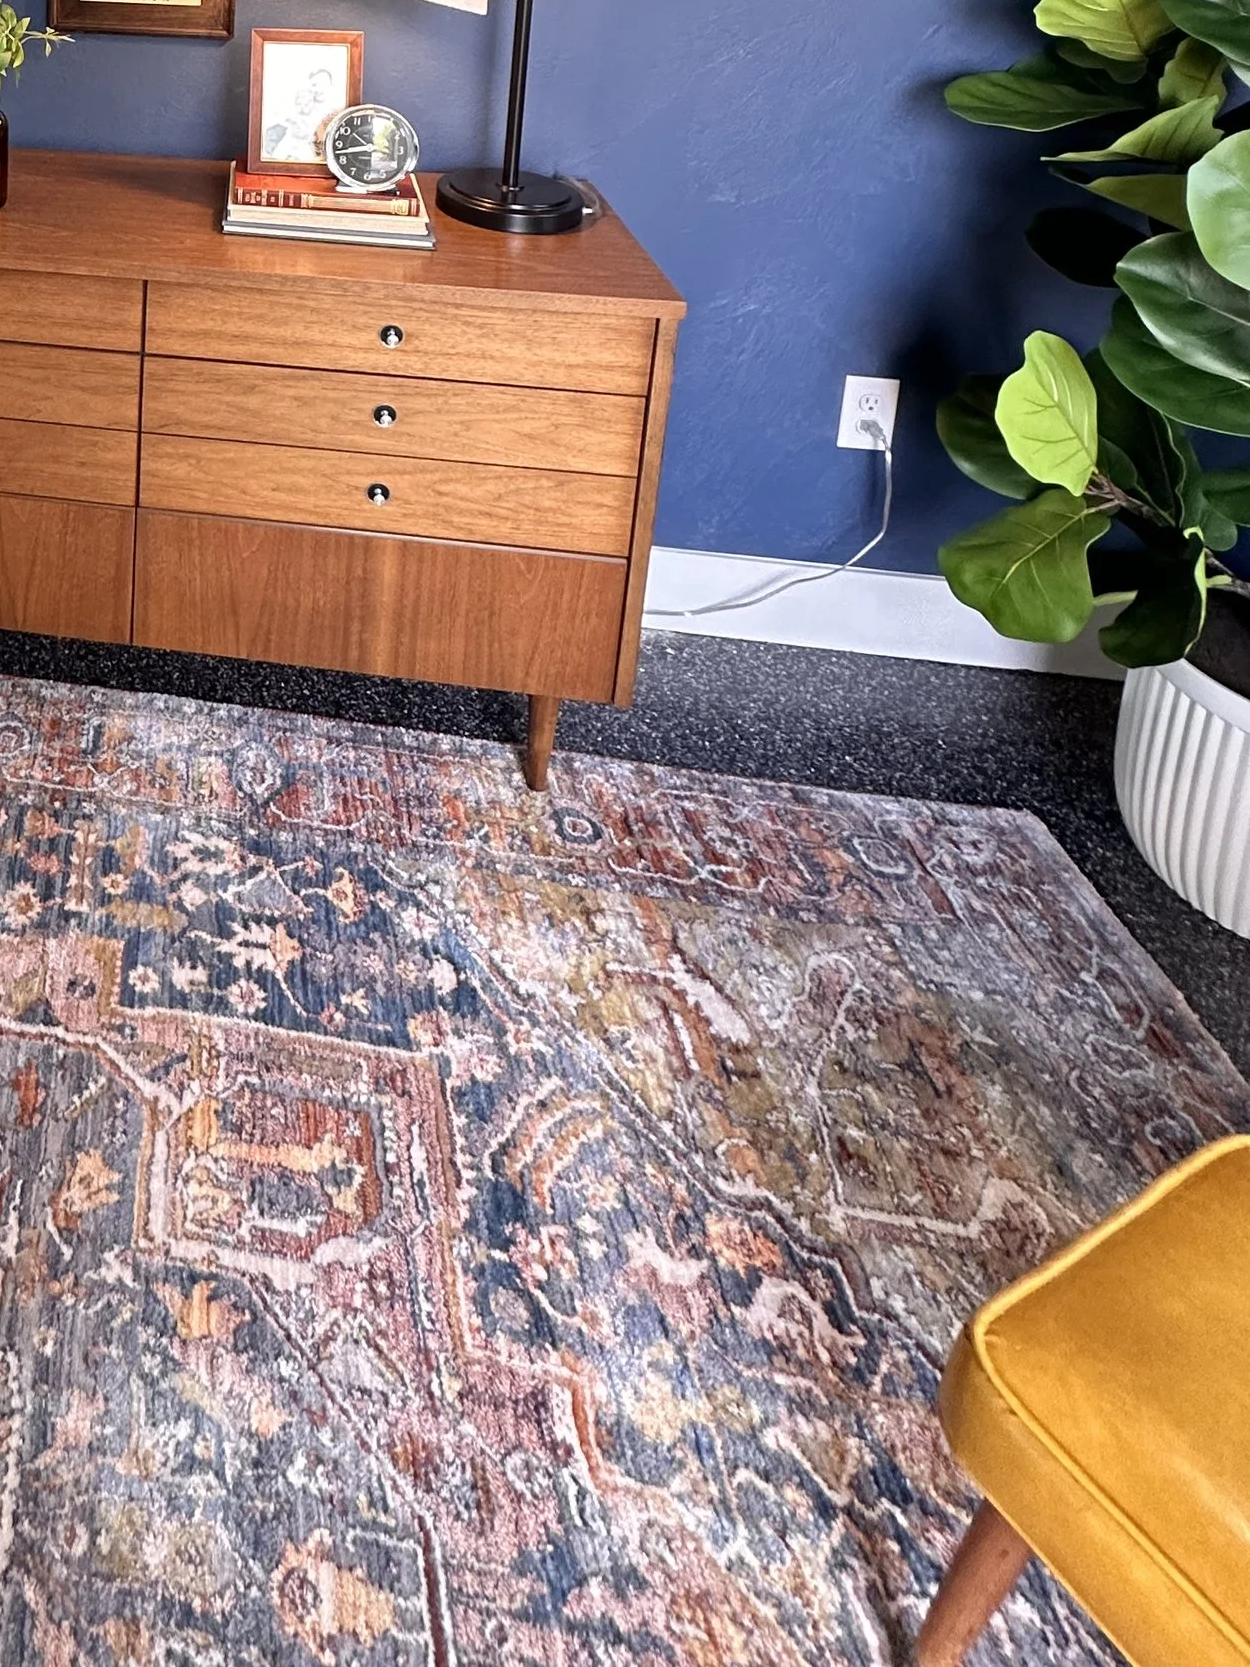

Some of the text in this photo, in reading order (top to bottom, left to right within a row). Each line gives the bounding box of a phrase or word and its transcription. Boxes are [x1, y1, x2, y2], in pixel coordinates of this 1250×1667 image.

[353, 117, 361, 126] 11
[339, 126, 351, 136] 10
[334, 140, 344, 150] 9
[397, 146, 404, 155] 3
[339, 155, 347, 165] 8
[350, 167, 357, 176] 7
[363, 171, 372, 181] 6
[379, 169, 387, 179] 5
